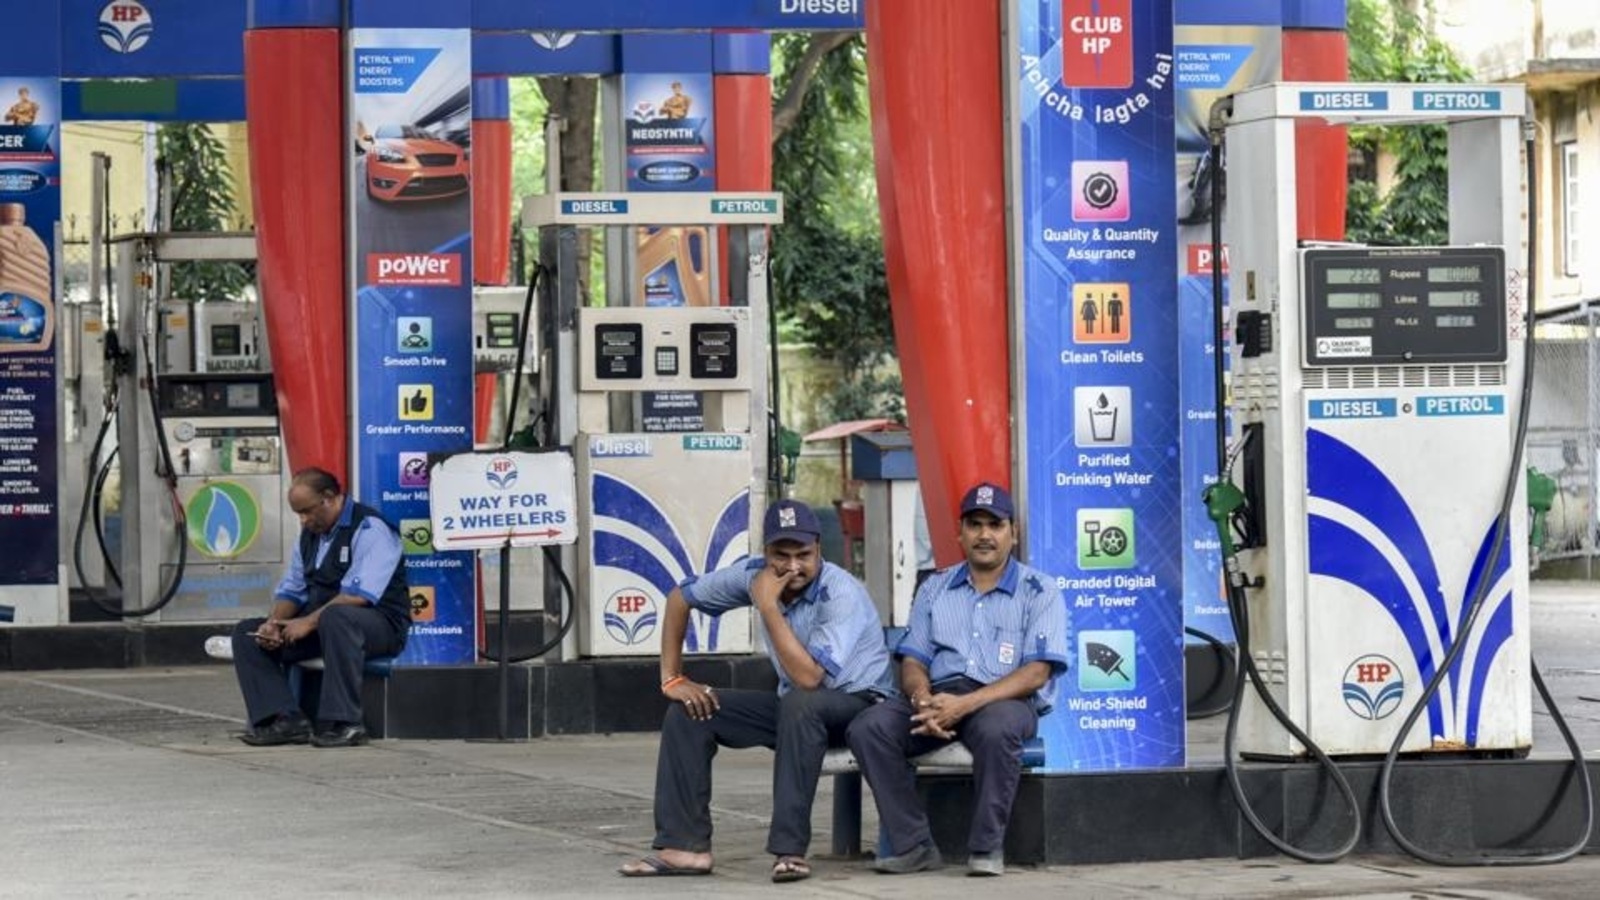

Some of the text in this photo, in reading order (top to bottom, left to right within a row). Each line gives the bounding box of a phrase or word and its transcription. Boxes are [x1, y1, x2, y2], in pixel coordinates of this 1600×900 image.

[779, 0, 859, 14] Diesel
[111, 6, 142, 22] HP
[1070, 16, 1123, 34] CLUB
[1082, 37, 1111, 54] HP
[359, 56, 415, 65] PETROL WITH
[1178, 53, 1231, 61] PETROL WITH
[359, 66, 392, 75] ENERGY
[1178, 63, 1210, 71] ENERGY
[359, 77, 404, 86] BOOSTERS
[1178, 73, 1220, 82] BOOSTERS
[1020, 52, 1173, 124] Achcha lagta hai
[1313, 92, 1491, 108] DIESEL PETROL
[632, 128, 693, 140] NEOSYNTH
[571, 201, 769, 212] DIESEL PETROL
[1043, 228, 1159, 243] Quality & Quantity
[1067, 247, 1136, 260] Assurance
[1389, 269, 1421, 280] Rupees
[383, 356, 447, 366] Smooth Drive
[1061, 350, 1144, 363] Clean Toilets
[1322, 398, 1493, 417] DIESEL PETROL
[366, 425, 466, 435] Greater Performance
[595, 439, 650, 455] Diesel
[1078, 453, 1131, 467] Purified
[493, 463, 512, 473] HP
[1055, 472, 1153, 488] Drinking Water
[382, 491, 413, 502] Better
[460, 493, 547, 511] WAY FOR
[443, 511, 566, 530] 2 WHEELERS
[404, 558, 462, 568] Acceleration
[1057, 575, 1157, 590] Branded Digital
[617, 596, 646, 613] HP
[1075, 595, 1138, 608] Air Tower
[415, 625, 463, 635] Emissions
[1357, 663, 1391, 683] HP
[1068, 697, 1147, 711] Wind-Shield
[1079, 715, 1136, 731] Cleaning
